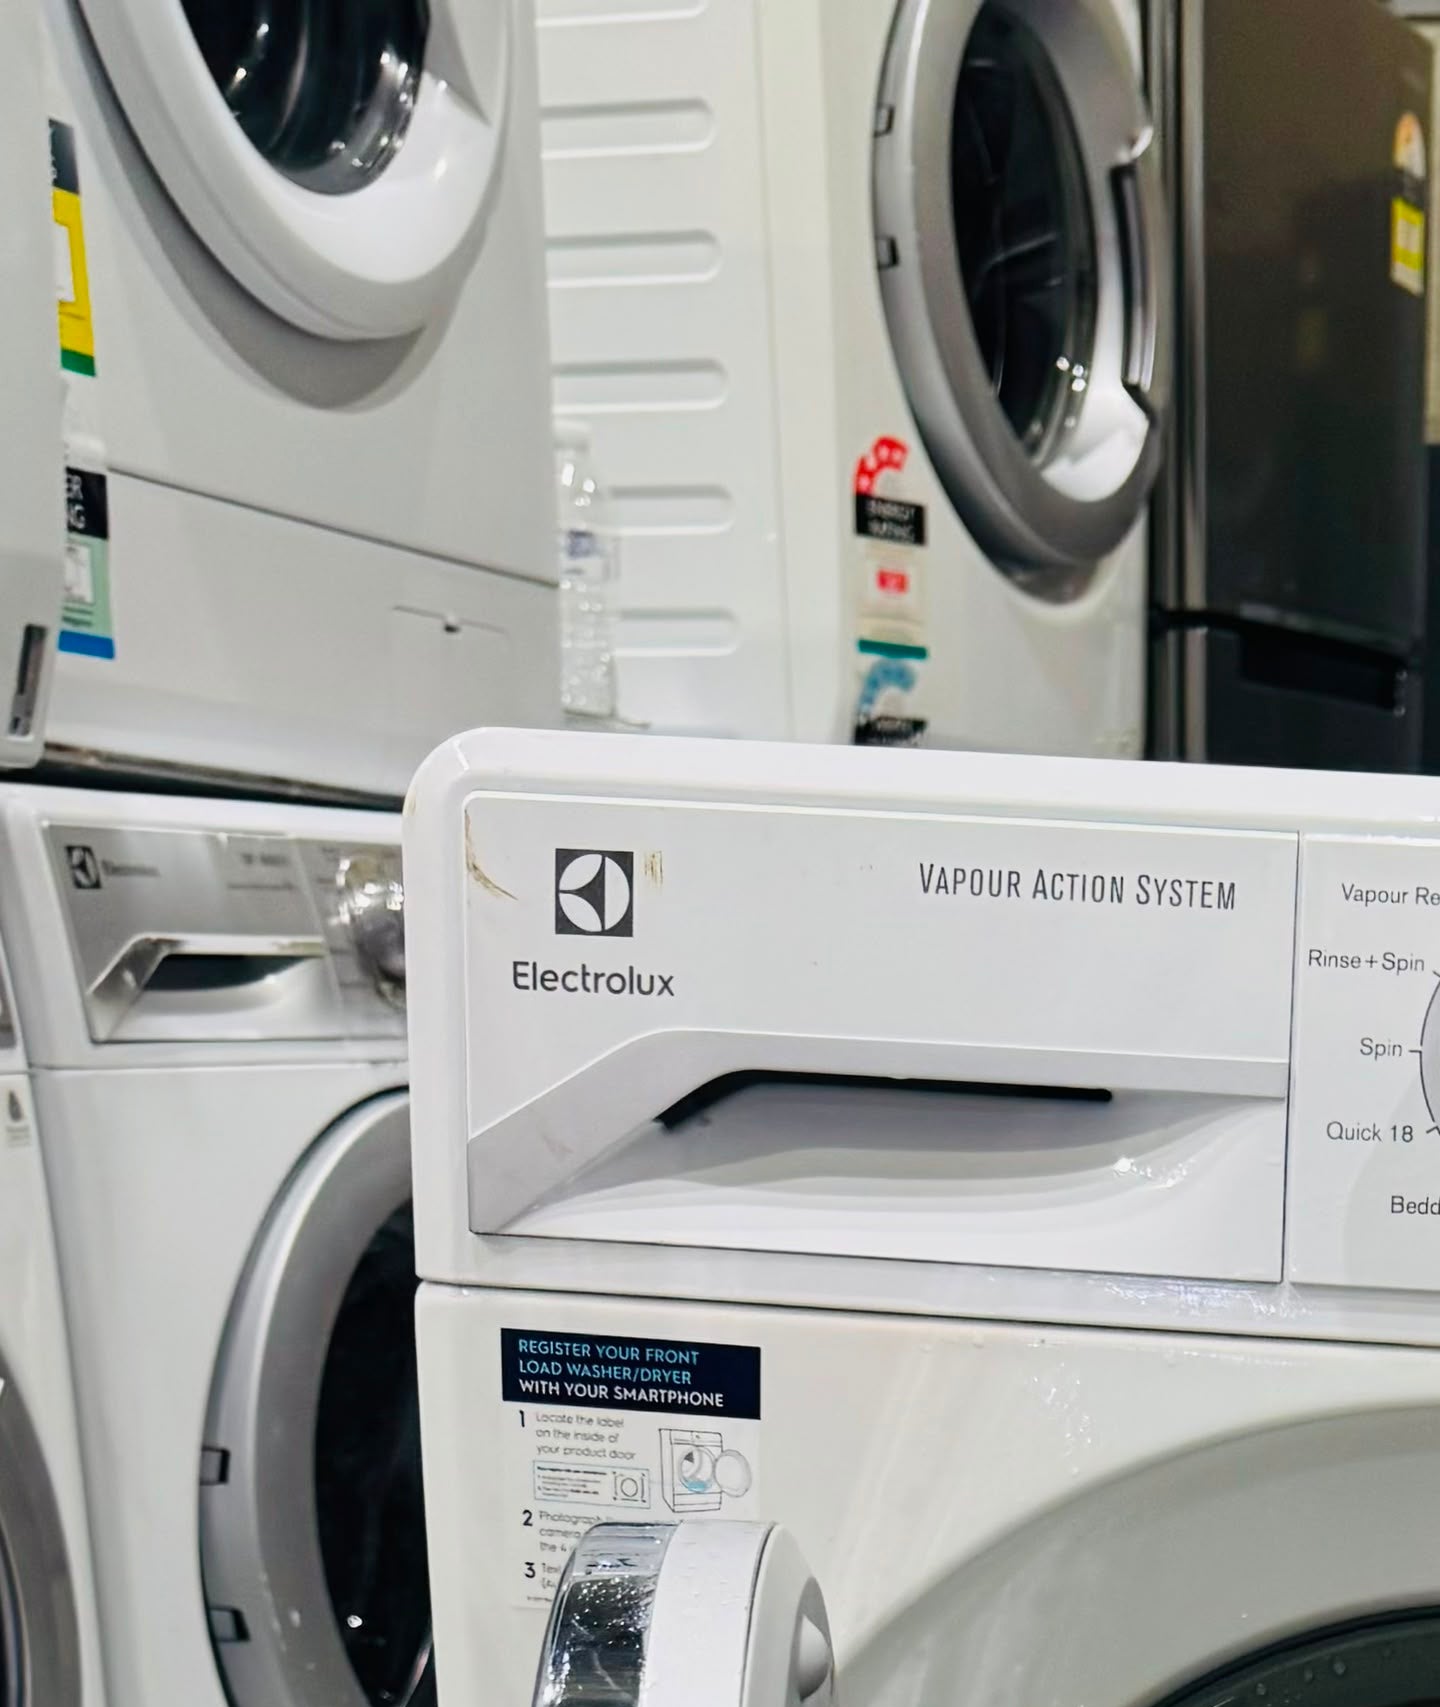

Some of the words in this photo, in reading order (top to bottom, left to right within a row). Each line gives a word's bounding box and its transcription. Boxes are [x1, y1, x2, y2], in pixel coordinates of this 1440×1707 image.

[919, 862, 1021, 899] VAPOUR
[1032, 869, 1124, 904] ACTION
[1136, 874, 1236, 911] SYSTEM
[1341, 884, 1408, 907] Vapour
[512, 961, 675, 998] Electrolux
[1359, 1038, 1403, 1060] Spin
[1326, 1121, 1382, 1144] Quick
[1389, 1124, 1414, 1143] 18
[518, 1339, 590, 1357] REGISTER
[597, 1344, 640, 1361] YOUR
[646, 1349, 700, 1365] FRONT
[519, 1360, 562, 1375] LOAD
[566, 1364, 692, 1385] WASHER/DRYER
[519, 1379, 560, 1397] WITH
[564, 1382, 609, 1399] YOUR
[614, 1386, 724, 1407] SMARTPHONE
[519, 1410, 526, 1427] 1
[536, 1412, 573, 1424] Locate
[576, 1414, 594, 1424] the
[597, 1415, 625, 1428] label
[536, 1428, 550, 1438] on
[553, 1430, 570, 1440] the
[574, 1431, 605, 1443] inside
[608, 1433, 619, 1443] of
[536, 1444, 560, 1455] your
[563, 1446, 606, 1459] product
[609, 1450, 636, 1460] door
[522, 1509, 533, 1527] 2
[524, 1562, 536, 1579] 3
